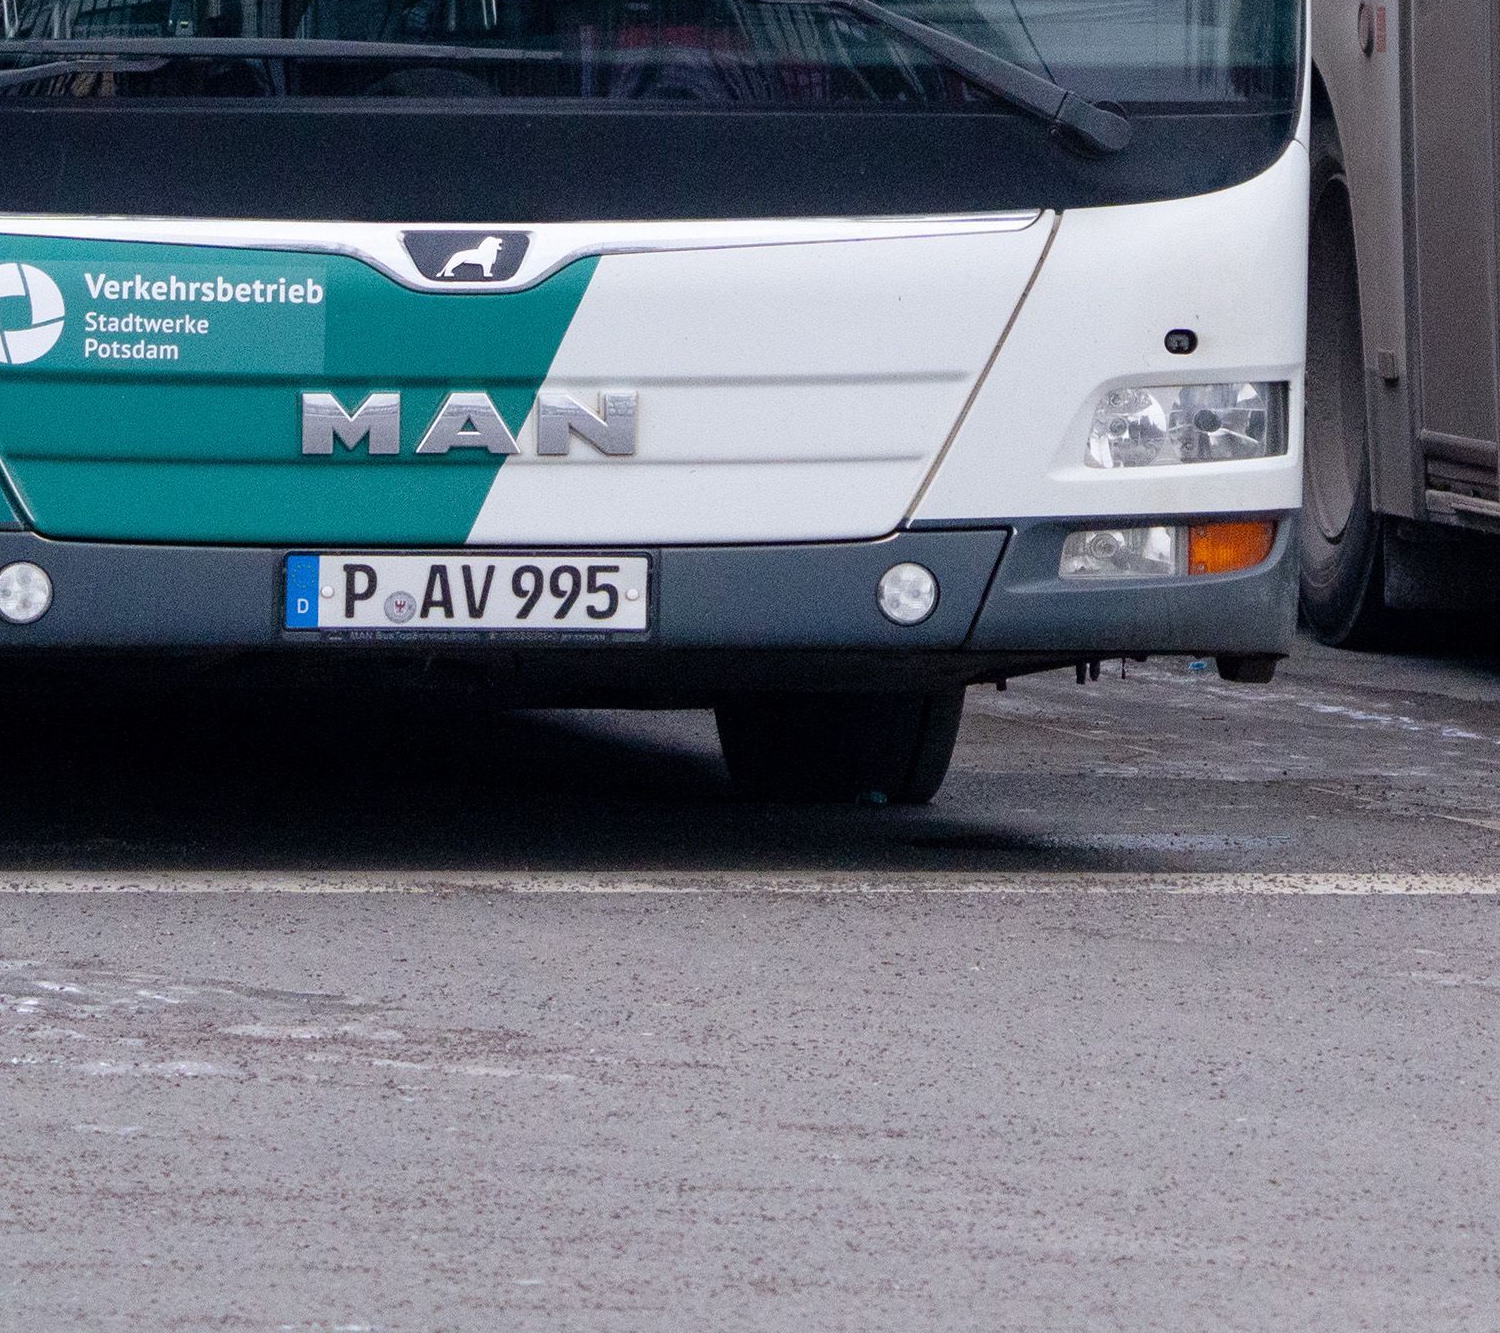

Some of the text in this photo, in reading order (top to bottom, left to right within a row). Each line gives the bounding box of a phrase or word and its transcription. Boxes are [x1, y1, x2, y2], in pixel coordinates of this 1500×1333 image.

[84, 273, 324, 304] Verkehrsbetrieb
[85, 312, 210, 334] Stadtwerke
[84, 338, 179, 359] Potsdam
[301, 391, 639, 455] MAN
[343, 563, 620, 620] P AV 995
[297, 599, 310, 614] D
